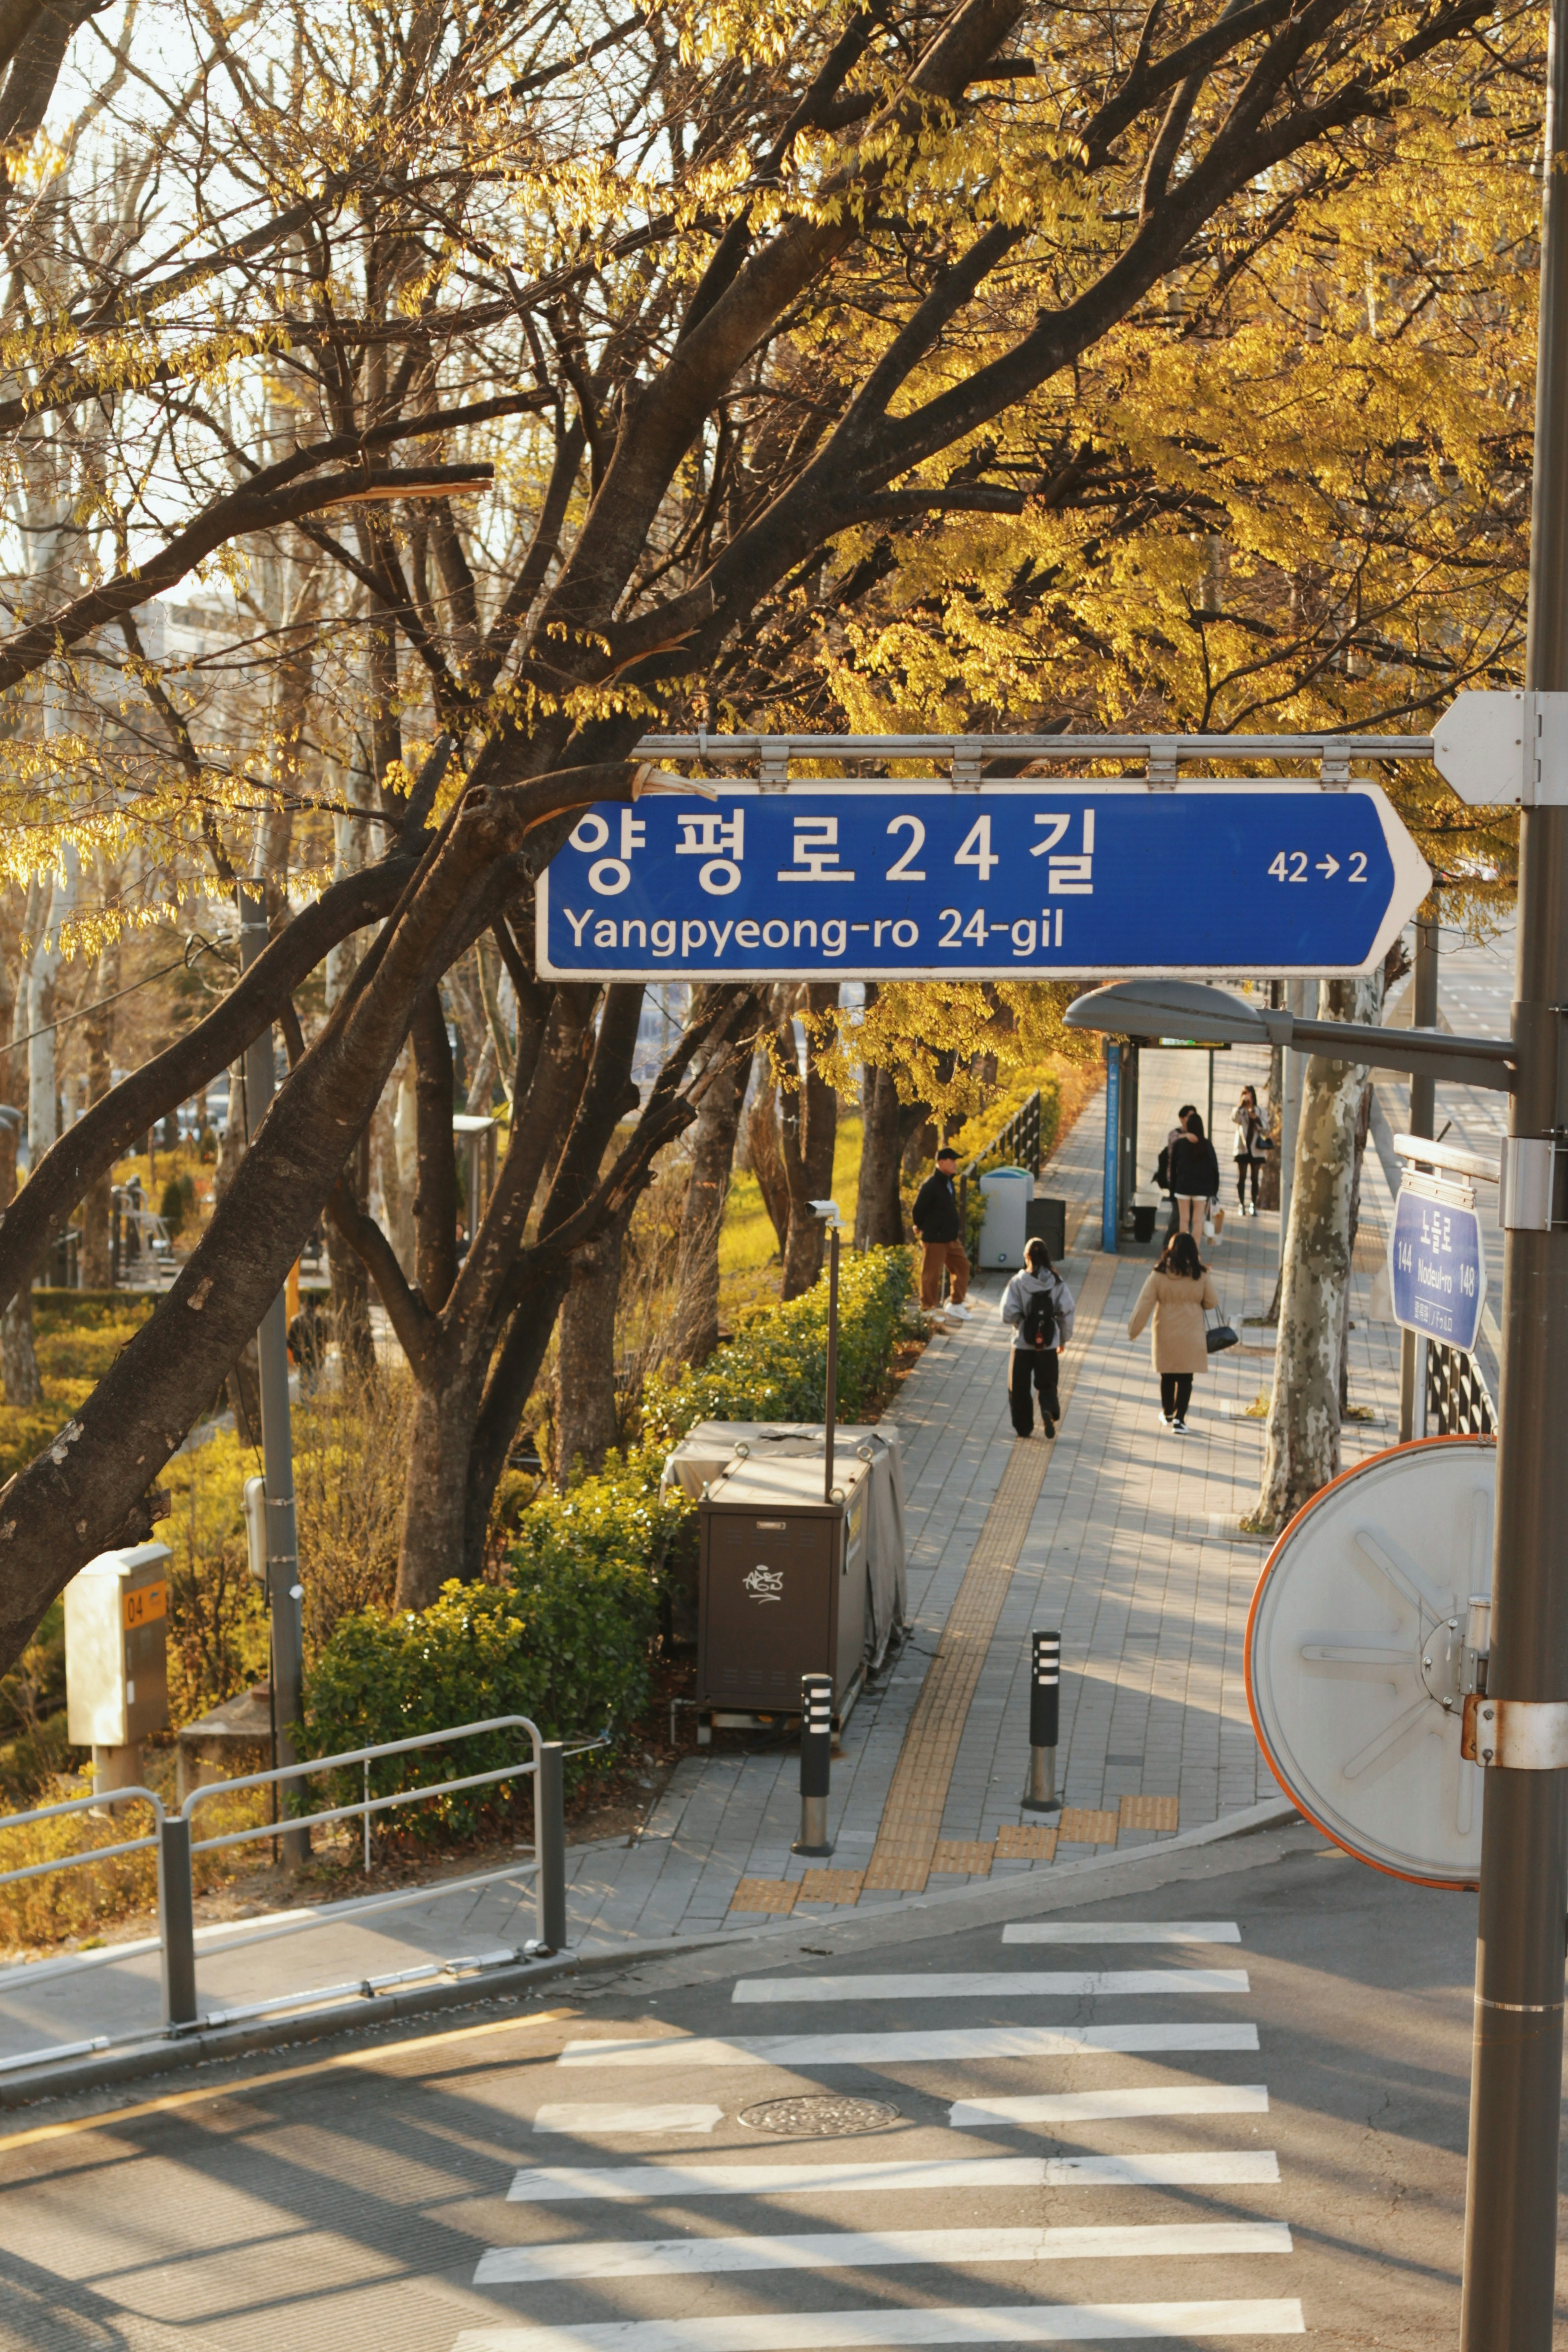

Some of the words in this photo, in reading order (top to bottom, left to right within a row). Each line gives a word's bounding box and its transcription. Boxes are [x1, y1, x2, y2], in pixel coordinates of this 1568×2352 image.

[1268, 851, 1308, 882] 42
[1348, 851, 1367, 882] 2
[563, 909, 919, 957] Yangpyeong-ro
[938, 909, 1063, 956] 24-gil
[1421, 1209, 1452, 1254] 노들로
[1398, 1241, 1412, 1274] 144
[1418, 1258, 1452, 1294] Nodeul-ro
[1460, 1263, 1474, 1298] 148
[128, 1594, 143, 1623] 04
